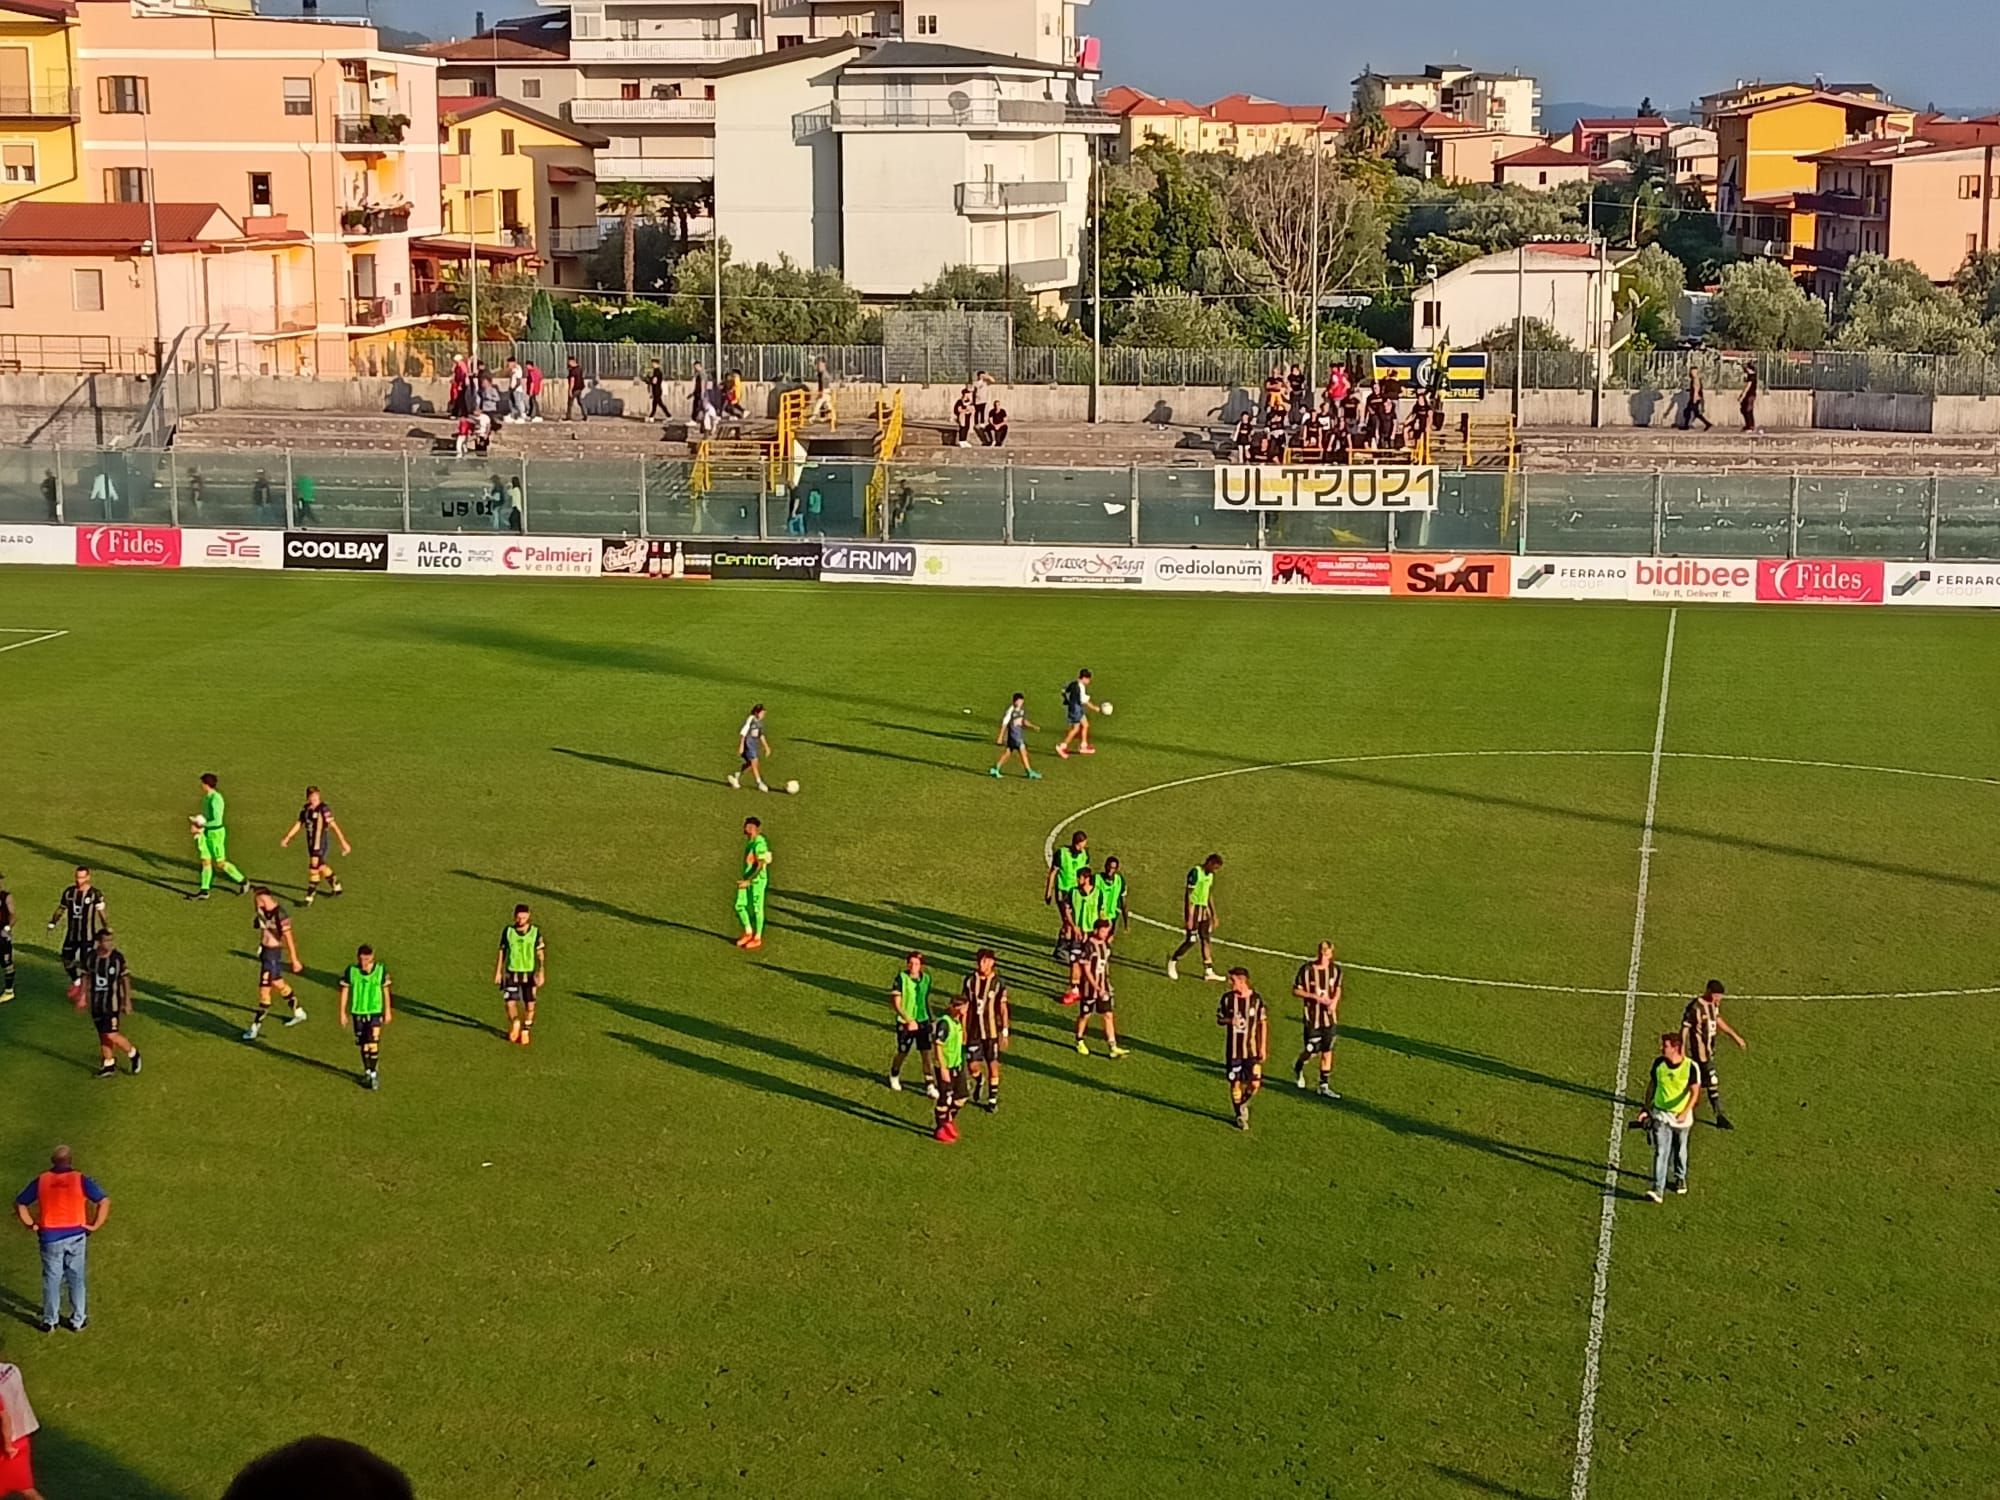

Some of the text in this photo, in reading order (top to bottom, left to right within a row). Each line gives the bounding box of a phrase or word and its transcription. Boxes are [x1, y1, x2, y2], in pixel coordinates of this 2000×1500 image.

[108, 529, 165, 554] Fides
[287, 540, 385, 563] COOLBAY
[525, 547, 593, 563] Palmieri
[849, 550, 912, 571] FRIMM
[417, 555, 462, 568] IVECO
[525, 563, 592, 574] vending
[1159, 559, 1263, 576] mediolanum
[1560, 568, 1627, 579] FERRARO
[1636, 559, 1750, 587] bidibee
[1795, 563, 1862, 590] Fides
